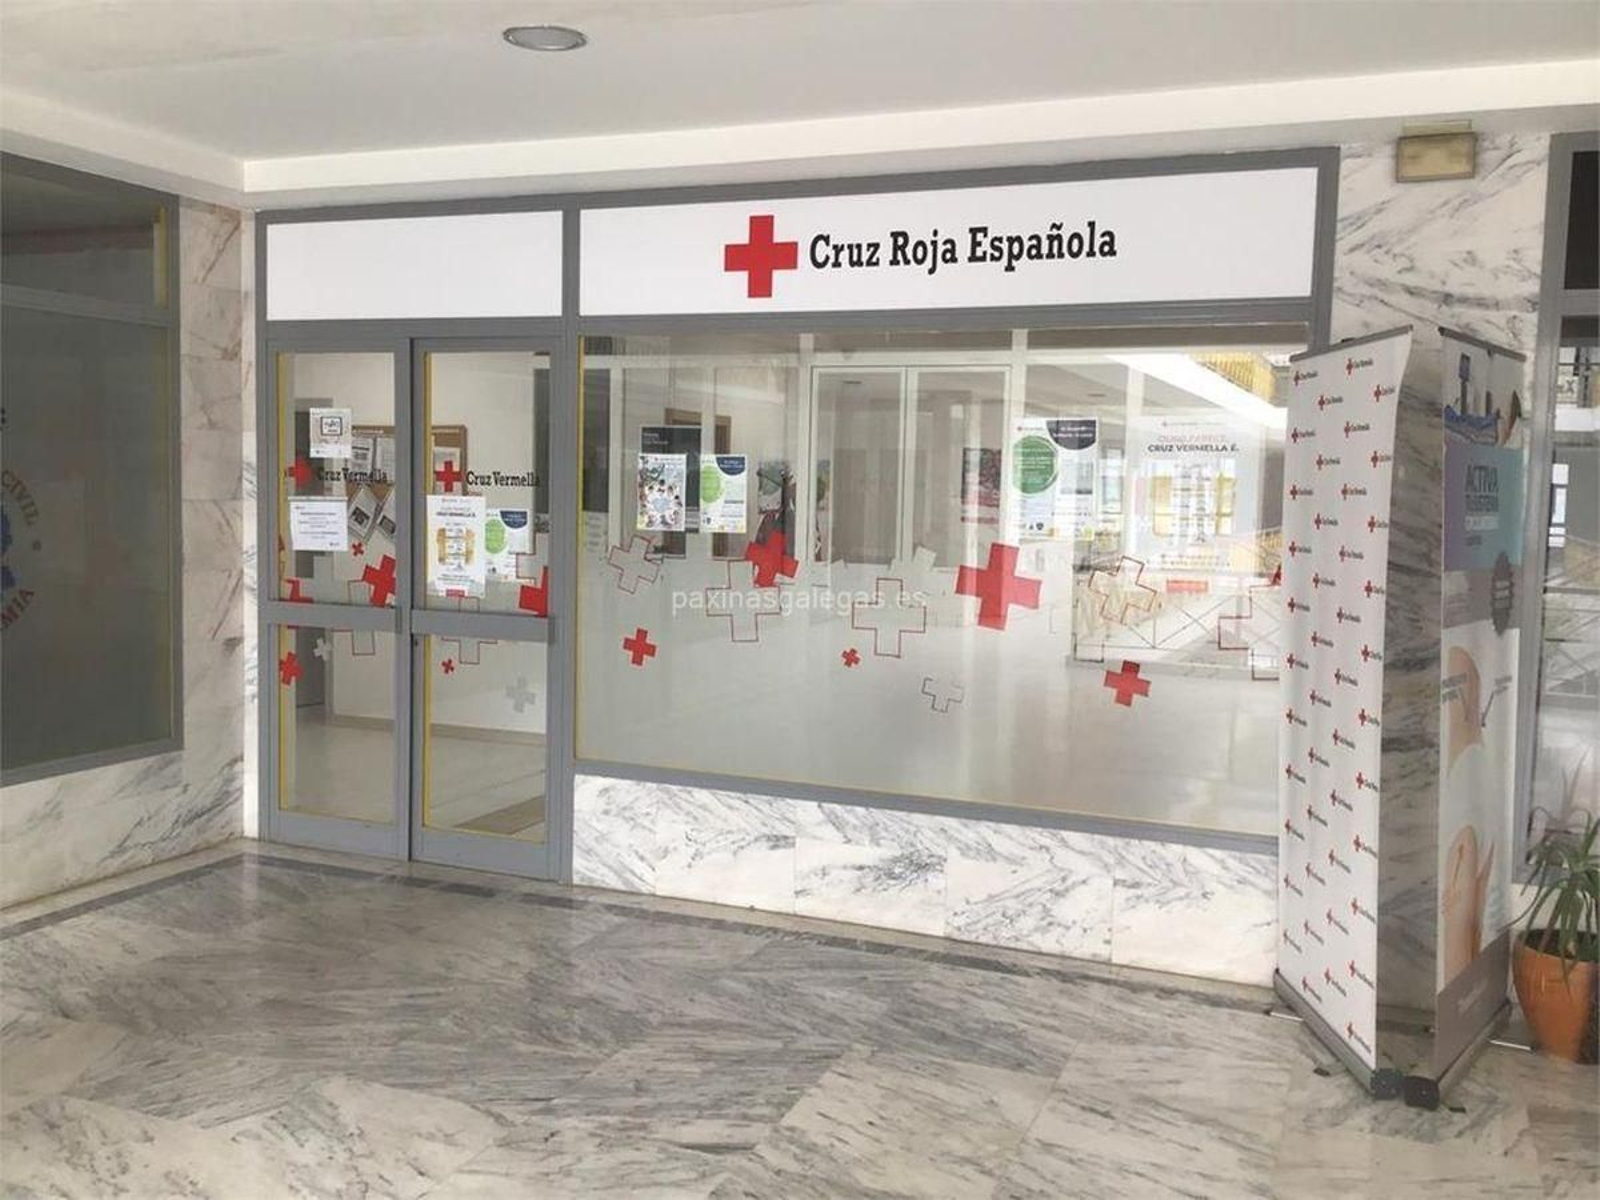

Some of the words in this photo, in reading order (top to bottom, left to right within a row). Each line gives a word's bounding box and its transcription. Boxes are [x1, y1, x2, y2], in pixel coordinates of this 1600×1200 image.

[809, 233, 881, 269] Cruz
[889, 228, 958, 275] Roja
[967, 221, 1117, 272] Española
[1, 469, 40, 527] CIVIL
[466, 470, 492, 486] Cruz
[492, 470, 541, 487] Vermella
